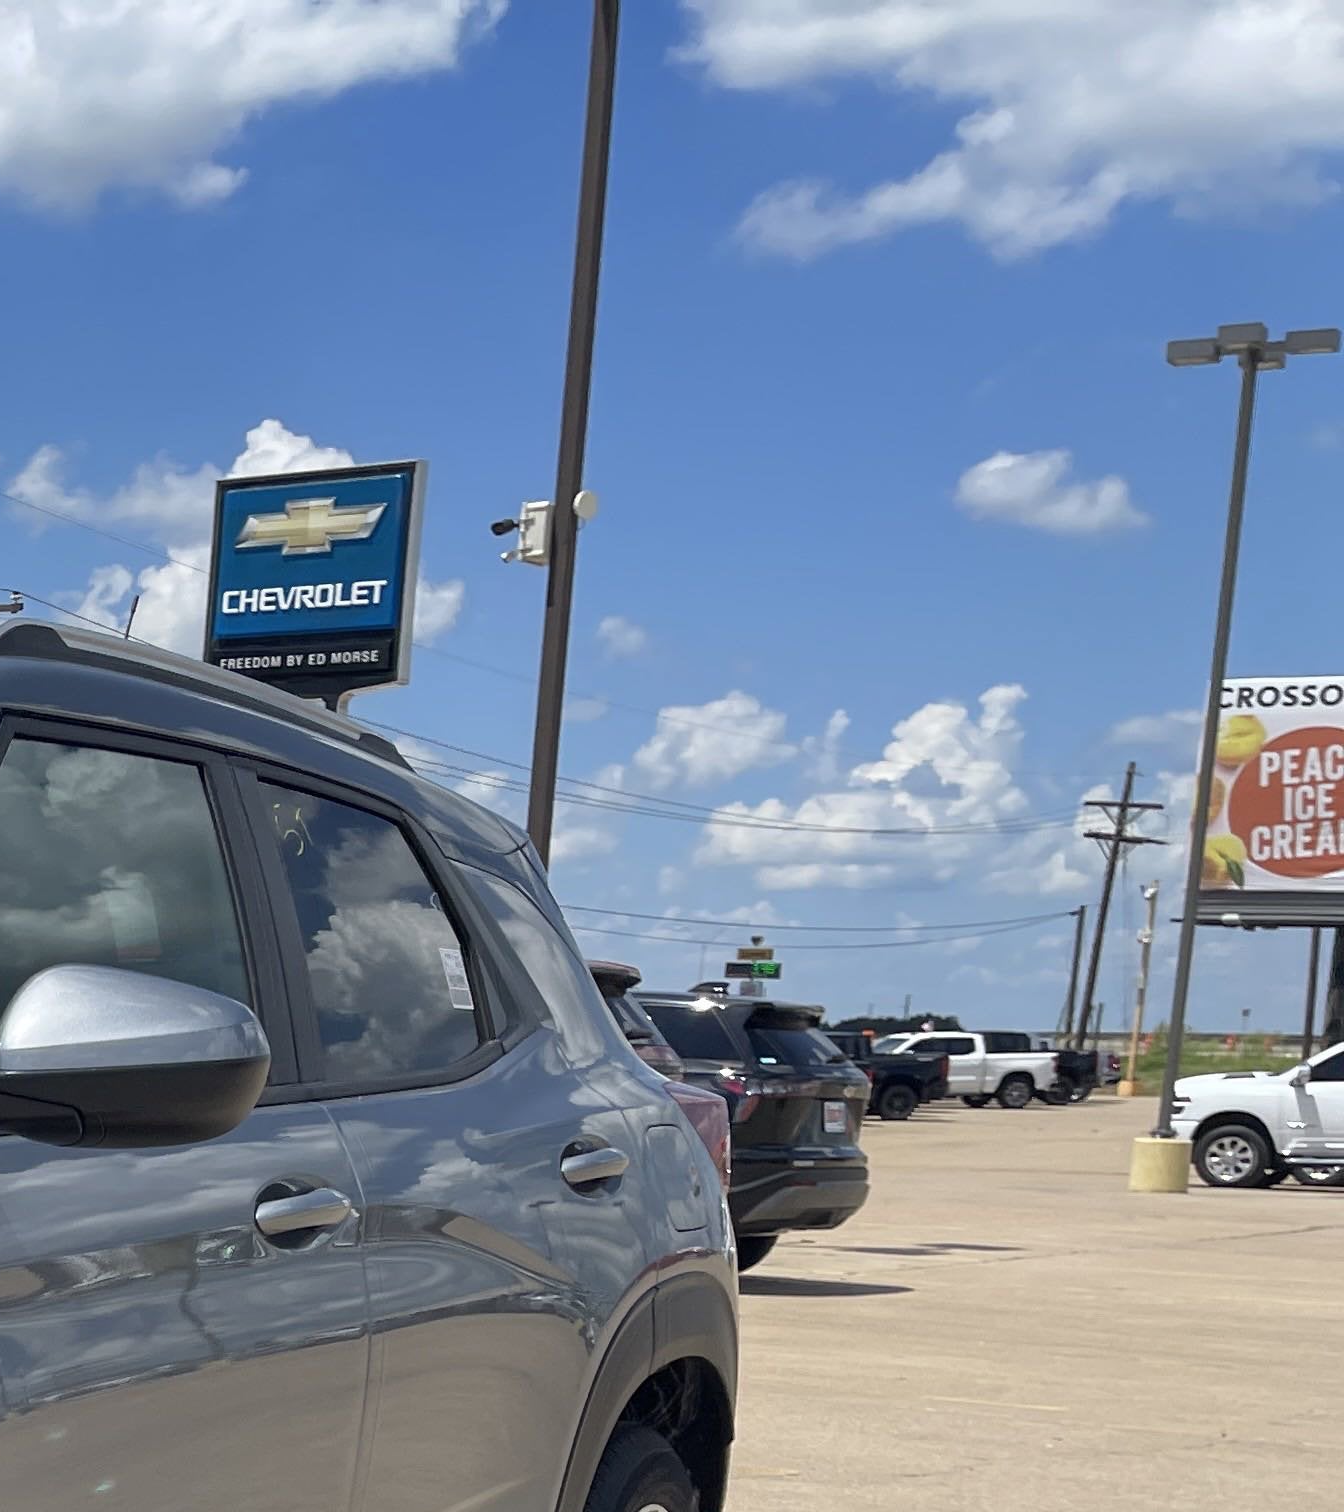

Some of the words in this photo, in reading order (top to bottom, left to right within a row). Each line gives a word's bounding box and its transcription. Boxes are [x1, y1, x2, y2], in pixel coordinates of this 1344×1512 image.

[221, 579, 388, 614] CHEVROLET
[219, 655, 282, 670] FREEDOM
[286, 653, 304, 668] BY
[307, 652, 326, 666] ED
[330, 649, 379, 664] MORSE
[1219, 684, 1344, 709] CROSSO
[1283, 782, 1336, 822] ICE
[1250, 819, 1344, 861] CREA
